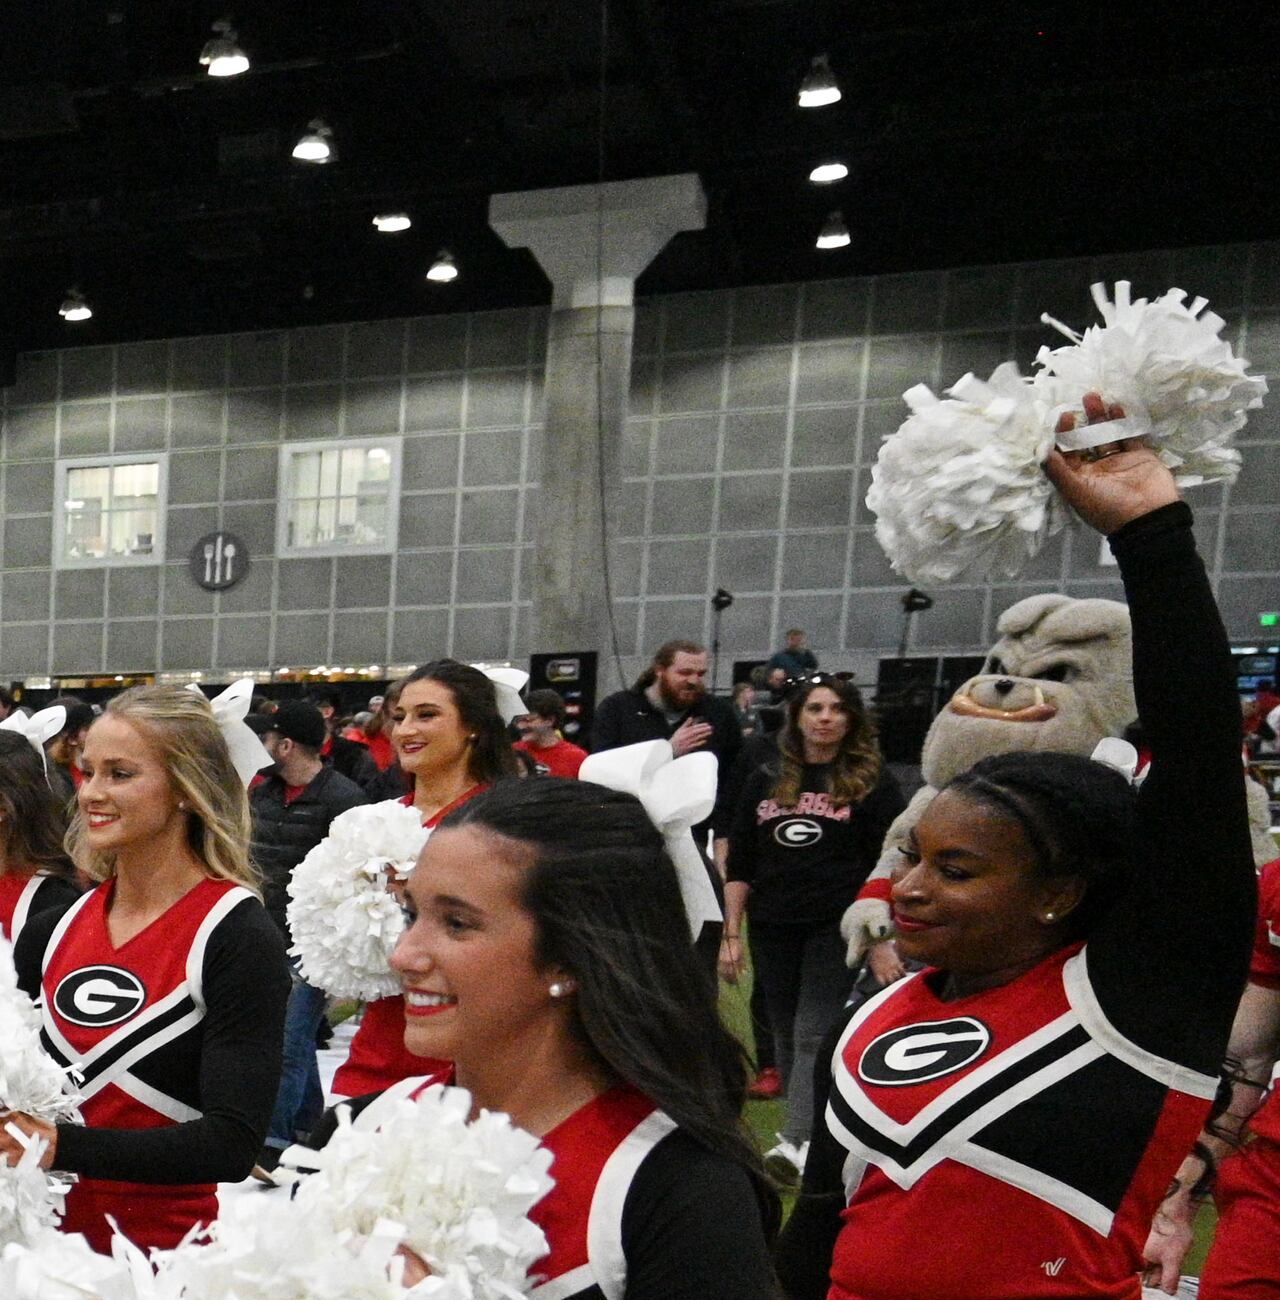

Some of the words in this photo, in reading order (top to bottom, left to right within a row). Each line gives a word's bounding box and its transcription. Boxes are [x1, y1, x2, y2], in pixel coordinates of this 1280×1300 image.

[774, 819, 823, 847] G
[53, 965, 145, 1027] G
[858, 1016, 990, 1086] G
